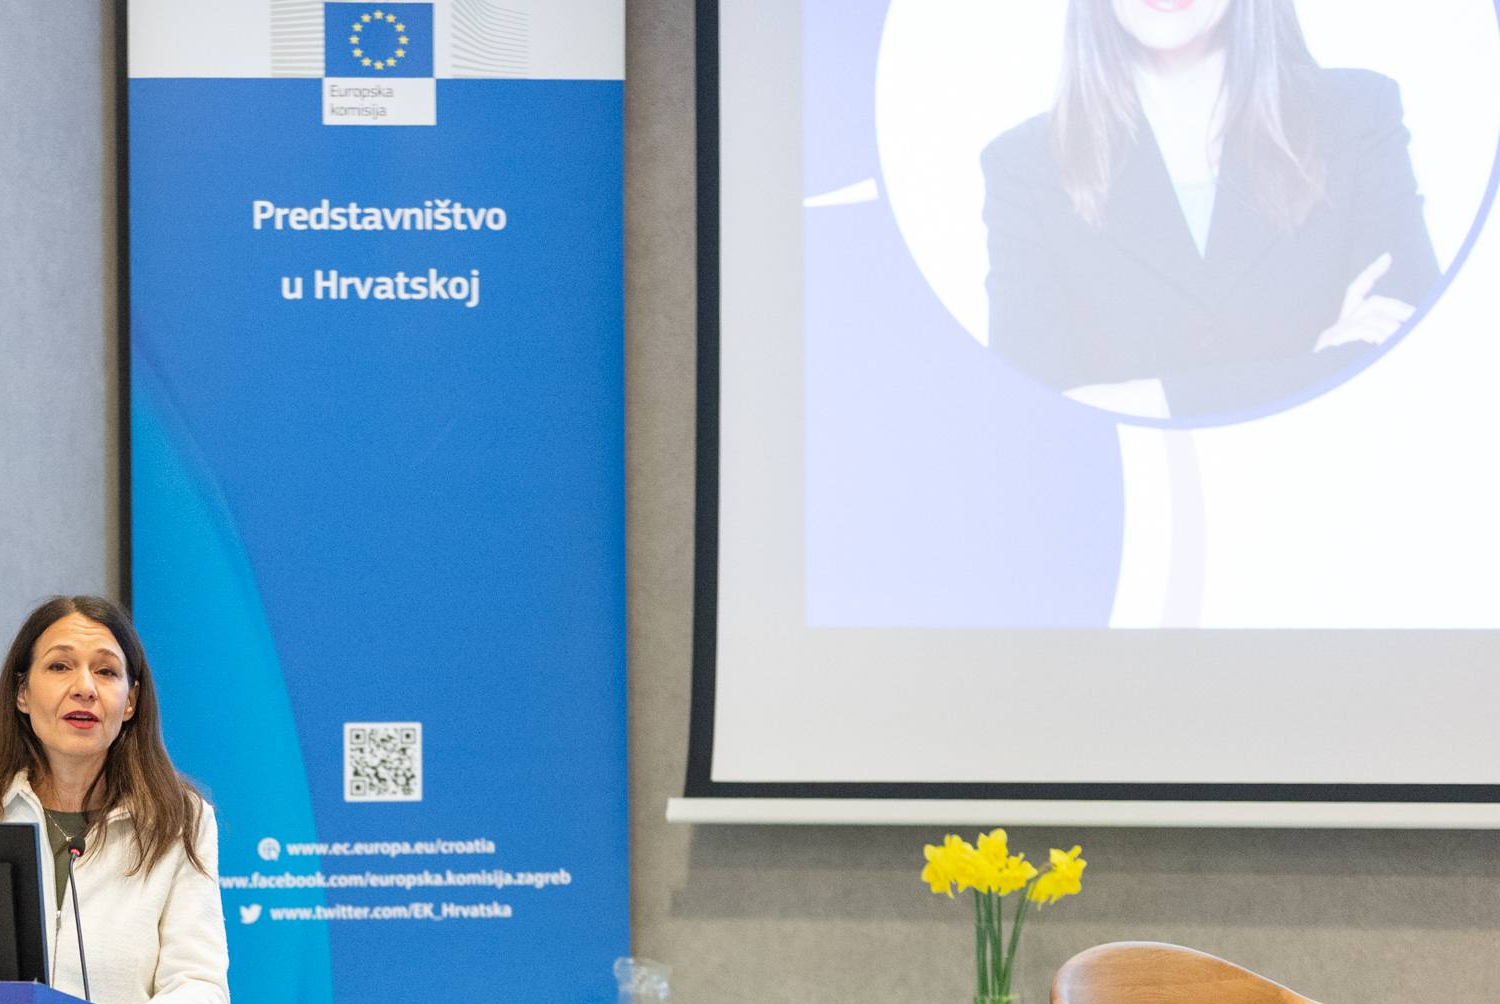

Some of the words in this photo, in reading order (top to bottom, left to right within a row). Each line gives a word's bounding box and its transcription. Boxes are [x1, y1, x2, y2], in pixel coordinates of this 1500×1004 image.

[329, 84, 394, 101] Europska
[330, 103, 388, 120] komisija
[252, 199, 507, 231] Predstavništvo
[281, 276, 304, 300] u
[313, 268, 480, 308] Hrvatskoj
[286, 838, 496, 858] www.ec.europa.eu/croatia
[219, 868, 572, 889] ww.facebook.com/europska.komisija.zagreb
[269, 901, 512, 921] www.twitter.com/EK_Hrvatska
